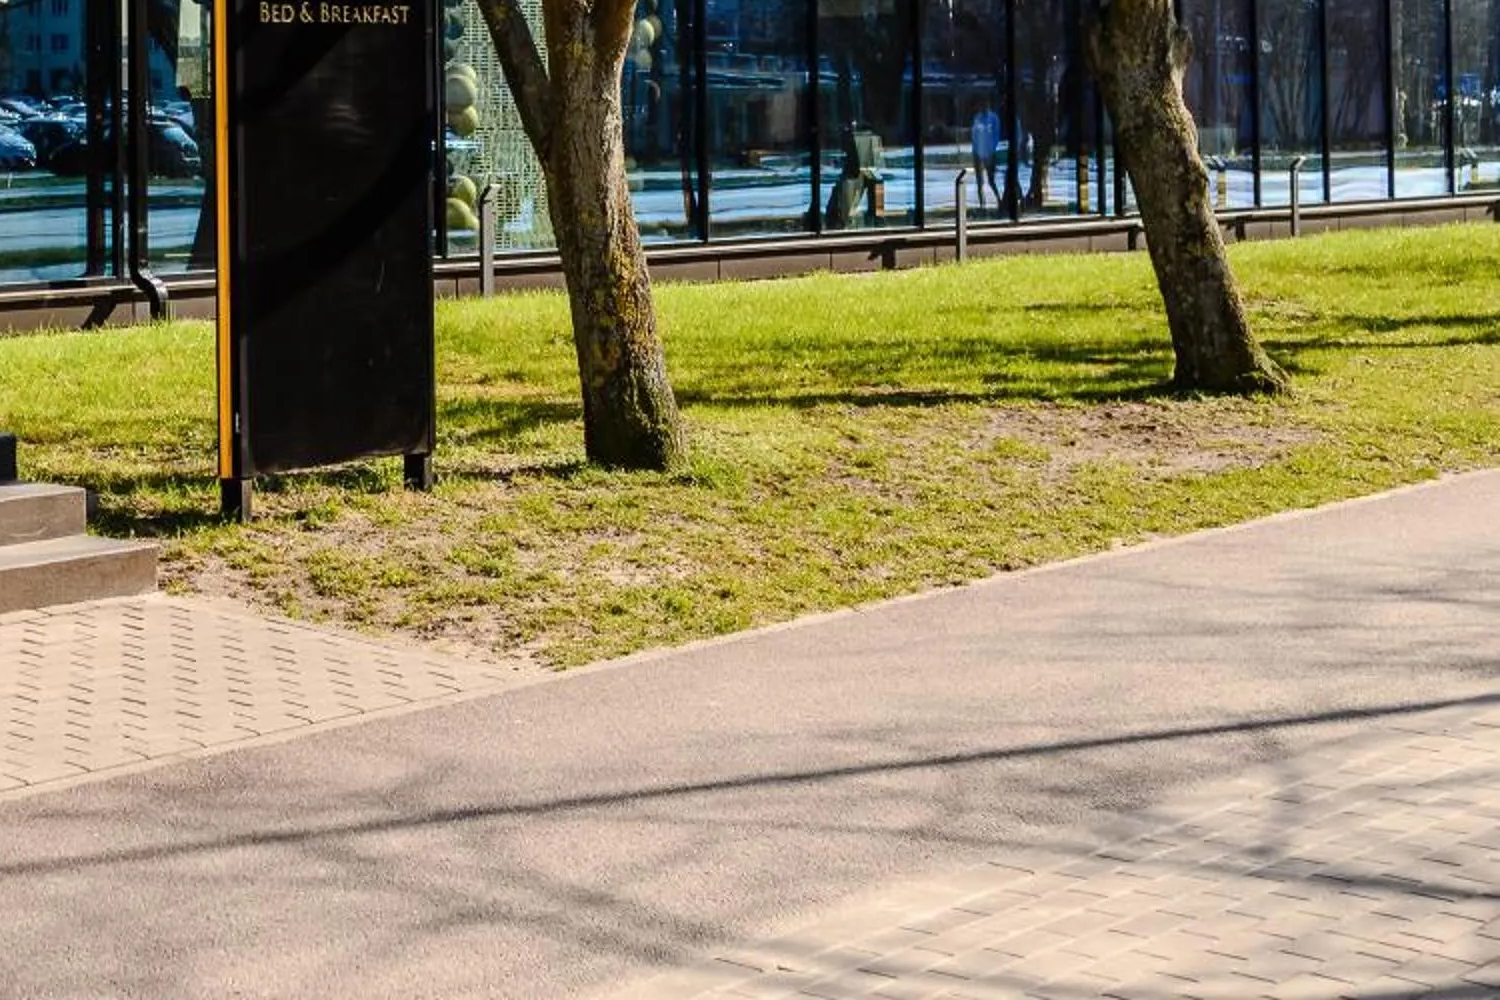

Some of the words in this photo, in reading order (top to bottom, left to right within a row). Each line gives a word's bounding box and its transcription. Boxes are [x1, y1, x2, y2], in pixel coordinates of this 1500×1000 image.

[259, 1, 295, 24] BED
[300, 1, 315, 23] &
[320, 2, 411, 25] BREAKFAST
